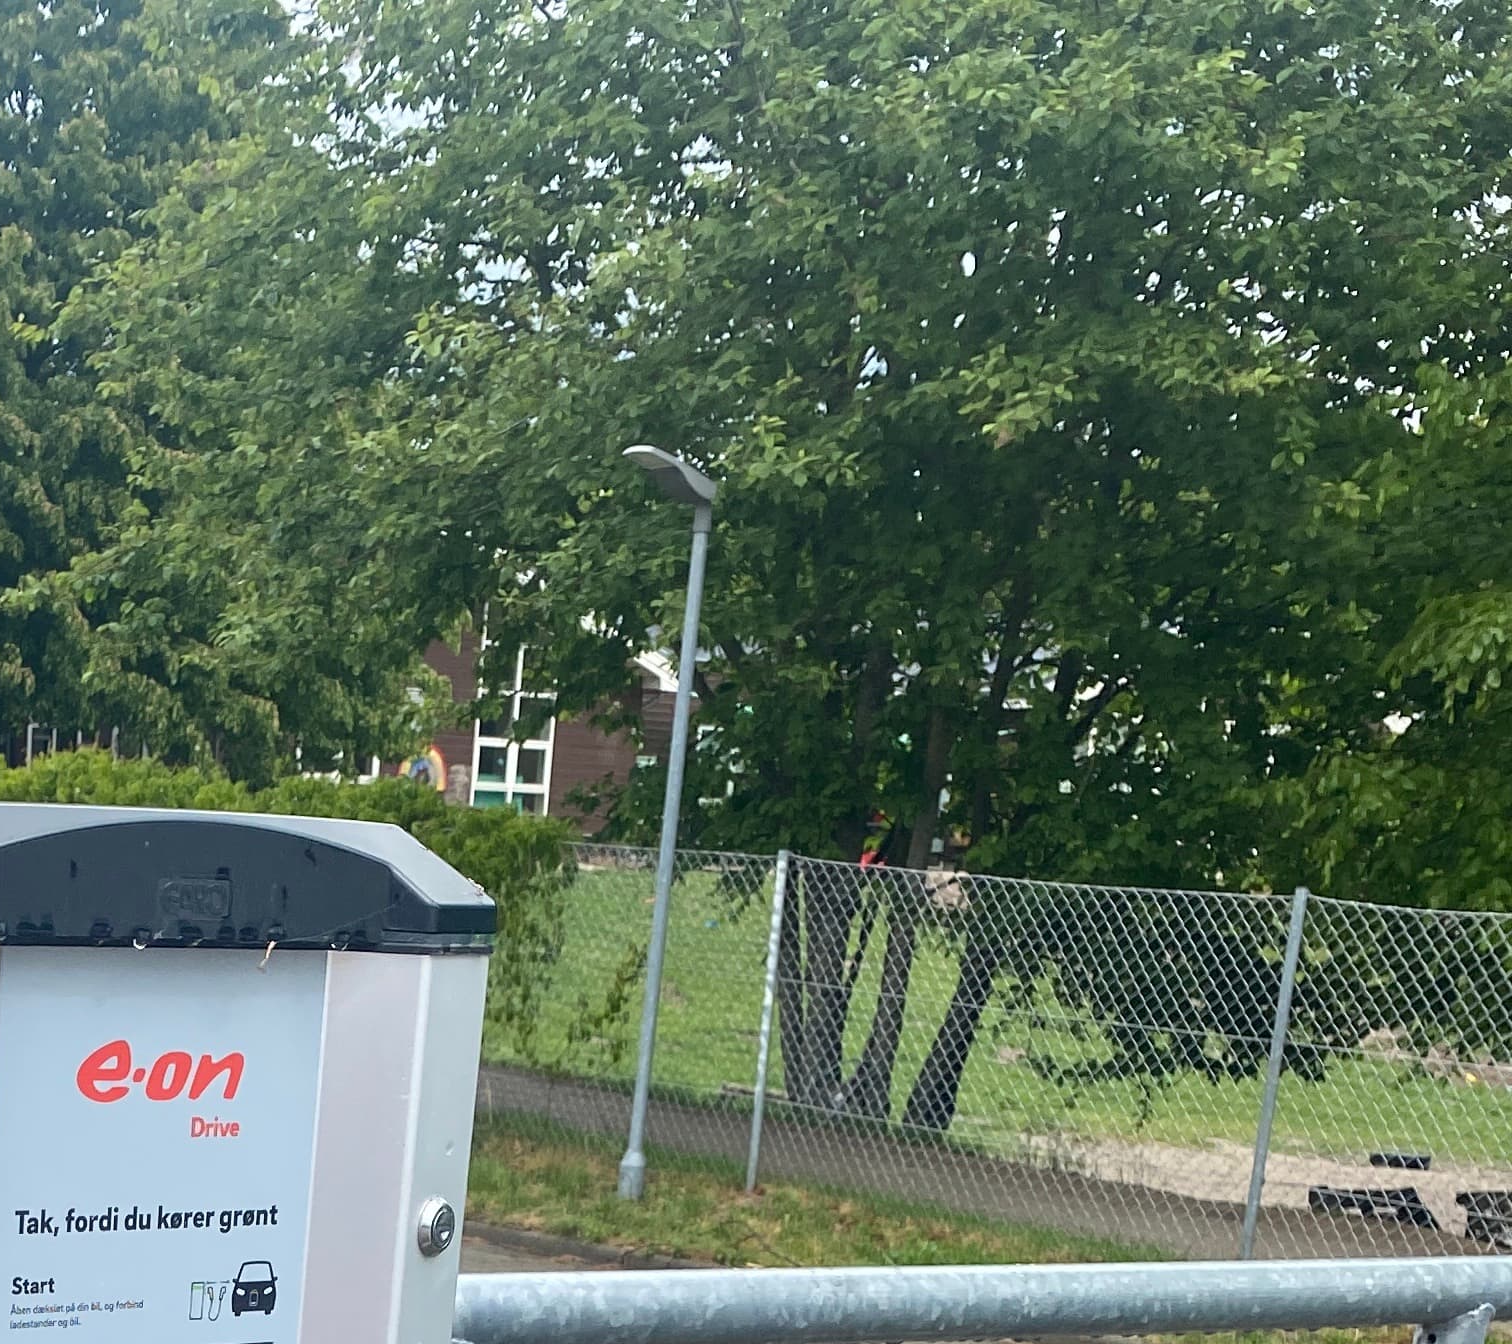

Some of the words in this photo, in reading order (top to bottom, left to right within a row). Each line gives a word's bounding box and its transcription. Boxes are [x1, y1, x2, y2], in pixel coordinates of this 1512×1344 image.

[191, 1116, 240, 1138] Drive
[15, 1210, 59, 1236] Tak,
[66, 1207, 118, 1232] fordi
[124, 1206, 150, 1230] du
[158, 1206, 214, 1229] kører
[219, 1205, 278, 1233] grønt
[11, 1276, 55, 1295] Start
[66, 1302, 75, 1313] på
[77, 1302, 89, 1311] din
[104, 1303, 113, 1312] og
